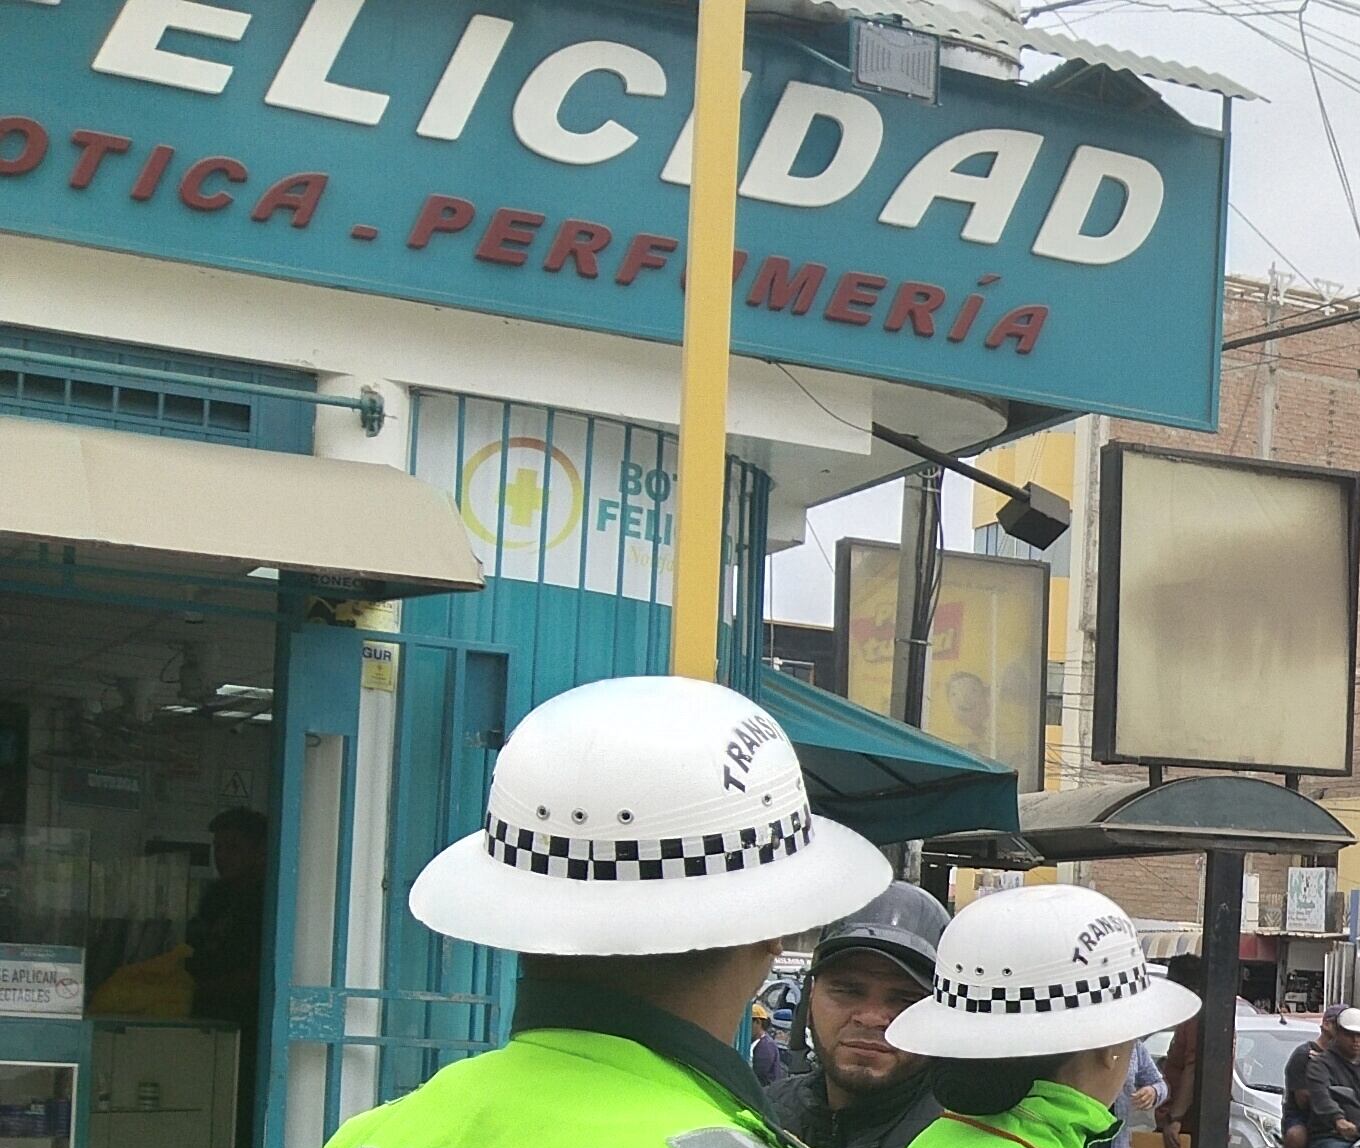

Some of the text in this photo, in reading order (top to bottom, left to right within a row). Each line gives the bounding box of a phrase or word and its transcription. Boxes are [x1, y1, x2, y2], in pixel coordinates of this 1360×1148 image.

[0, 0, 1165, 266] ELICDAD
[407, 193, 1051, 356] PERFMERÍA
[12, 968, 57, 985] APLICAN
